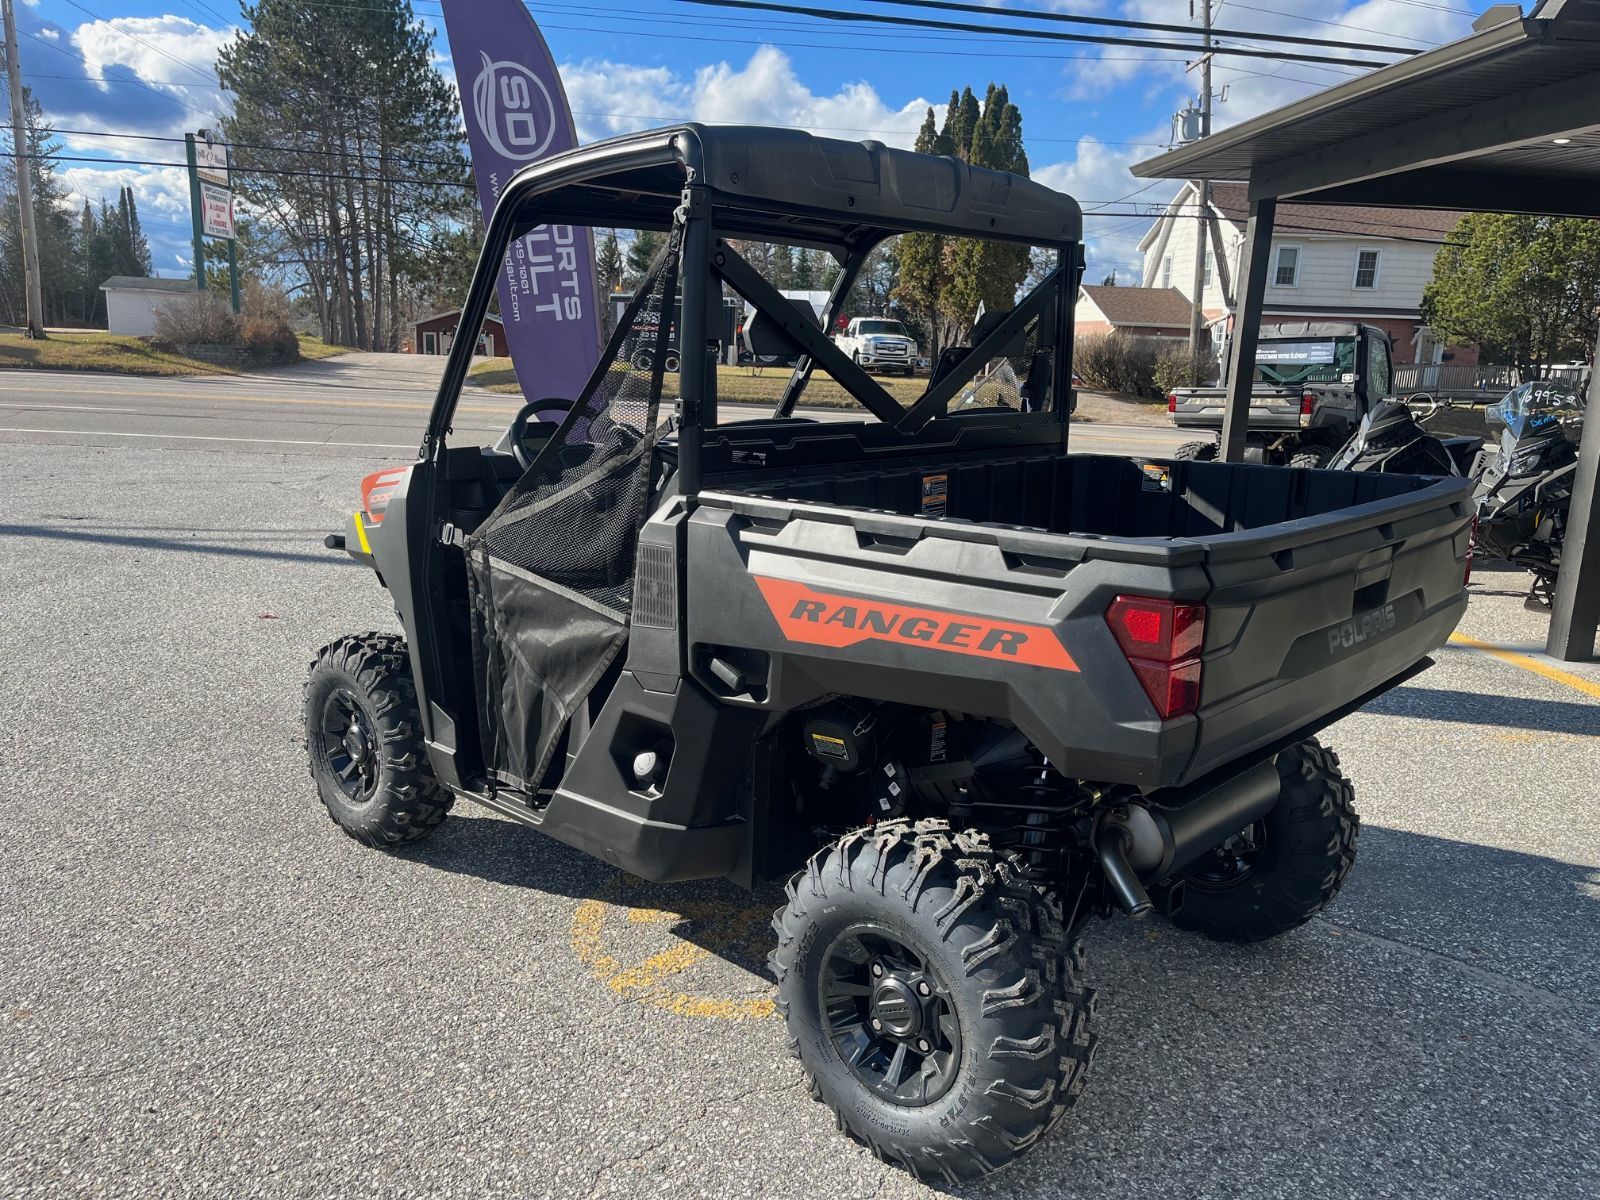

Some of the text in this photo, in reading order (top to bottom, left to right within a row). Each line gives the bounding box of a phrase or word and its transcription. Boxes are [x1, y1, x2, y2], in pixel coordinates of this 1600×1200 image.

[500, 75, 537, 146] SD
[788, 599, 1029, 656] RANGER
[1327, 604, 1396, 655] POLARIS
